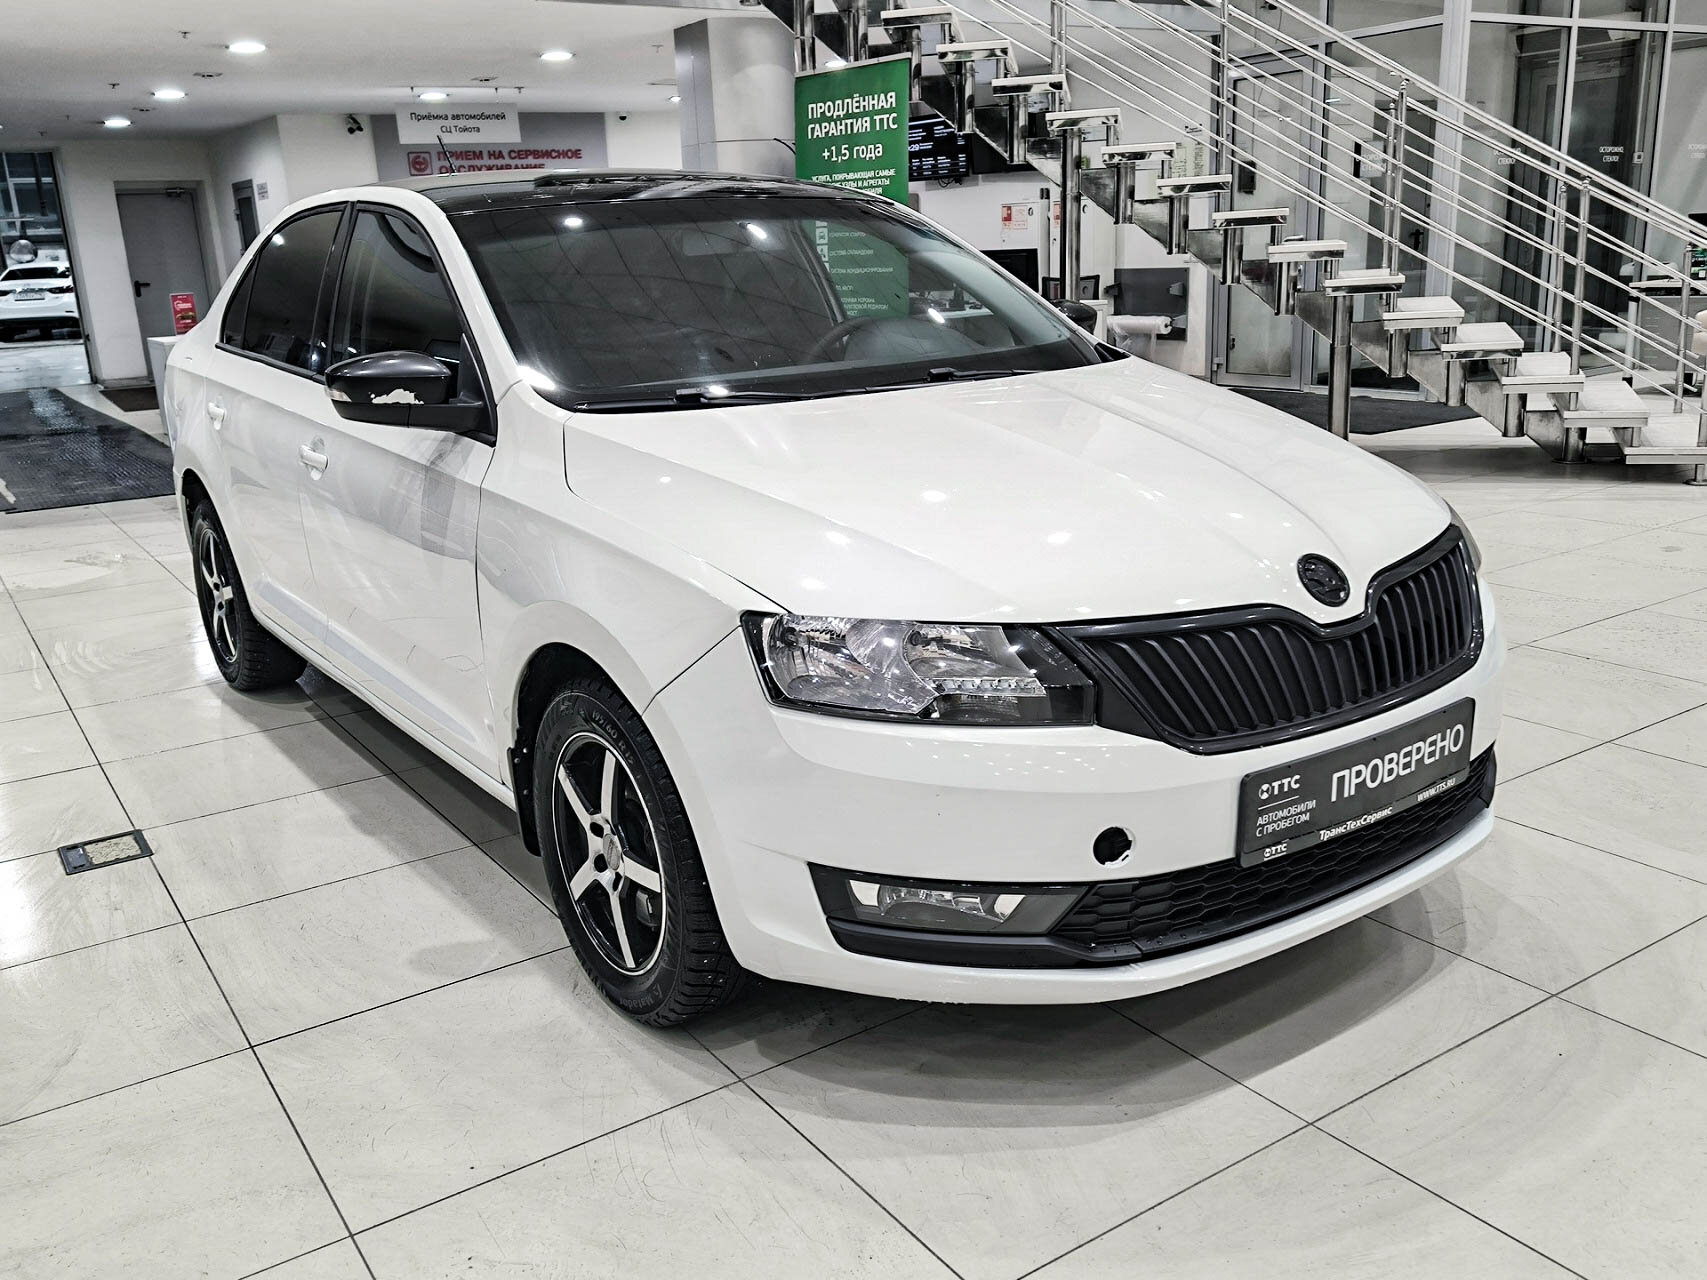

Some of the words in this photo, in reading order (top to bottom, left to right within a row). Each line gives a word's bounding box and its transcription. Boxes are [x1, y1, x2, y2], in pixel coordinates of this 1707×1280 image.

[808, 91, 896, 119] ПРОДЛЁННАЯ
[410, 112, 449, 122] Приёмка
[451, 112, 506, 121] автомобилей
[807, 117, 870, 139] ГАРАНТИЯ
[873, 113, 898, 131] ТТС
[440, 125, 452, 134] СЦ
[454, 125, 480, 133] Тойота
[487, 150, 506, 160] НА
[508, 148, 583, 160] СЕРВИСНОЕ
[822, 144, 850, 163] +1,5
[853, 143, 883, 161] года
[875, 168, 896, 176] САМЫЕ
[863, 178, 890, 187] АГРЕГАТЫ
[1331, 723, 1465, 802] ПРОВЕРЕНО
[1271, 774, 1301, 795] ТТС
[1256, 799, 1316, 826] АВТОМОБИЛИ
[1256, 827, 1263, 837] С
[1263, 812, 1310, 835] ПРОБЕГОМ
[1319, 806, 1393, 841] ТрансТехСервис
[1271, 843, 1288, 854] ТТС
